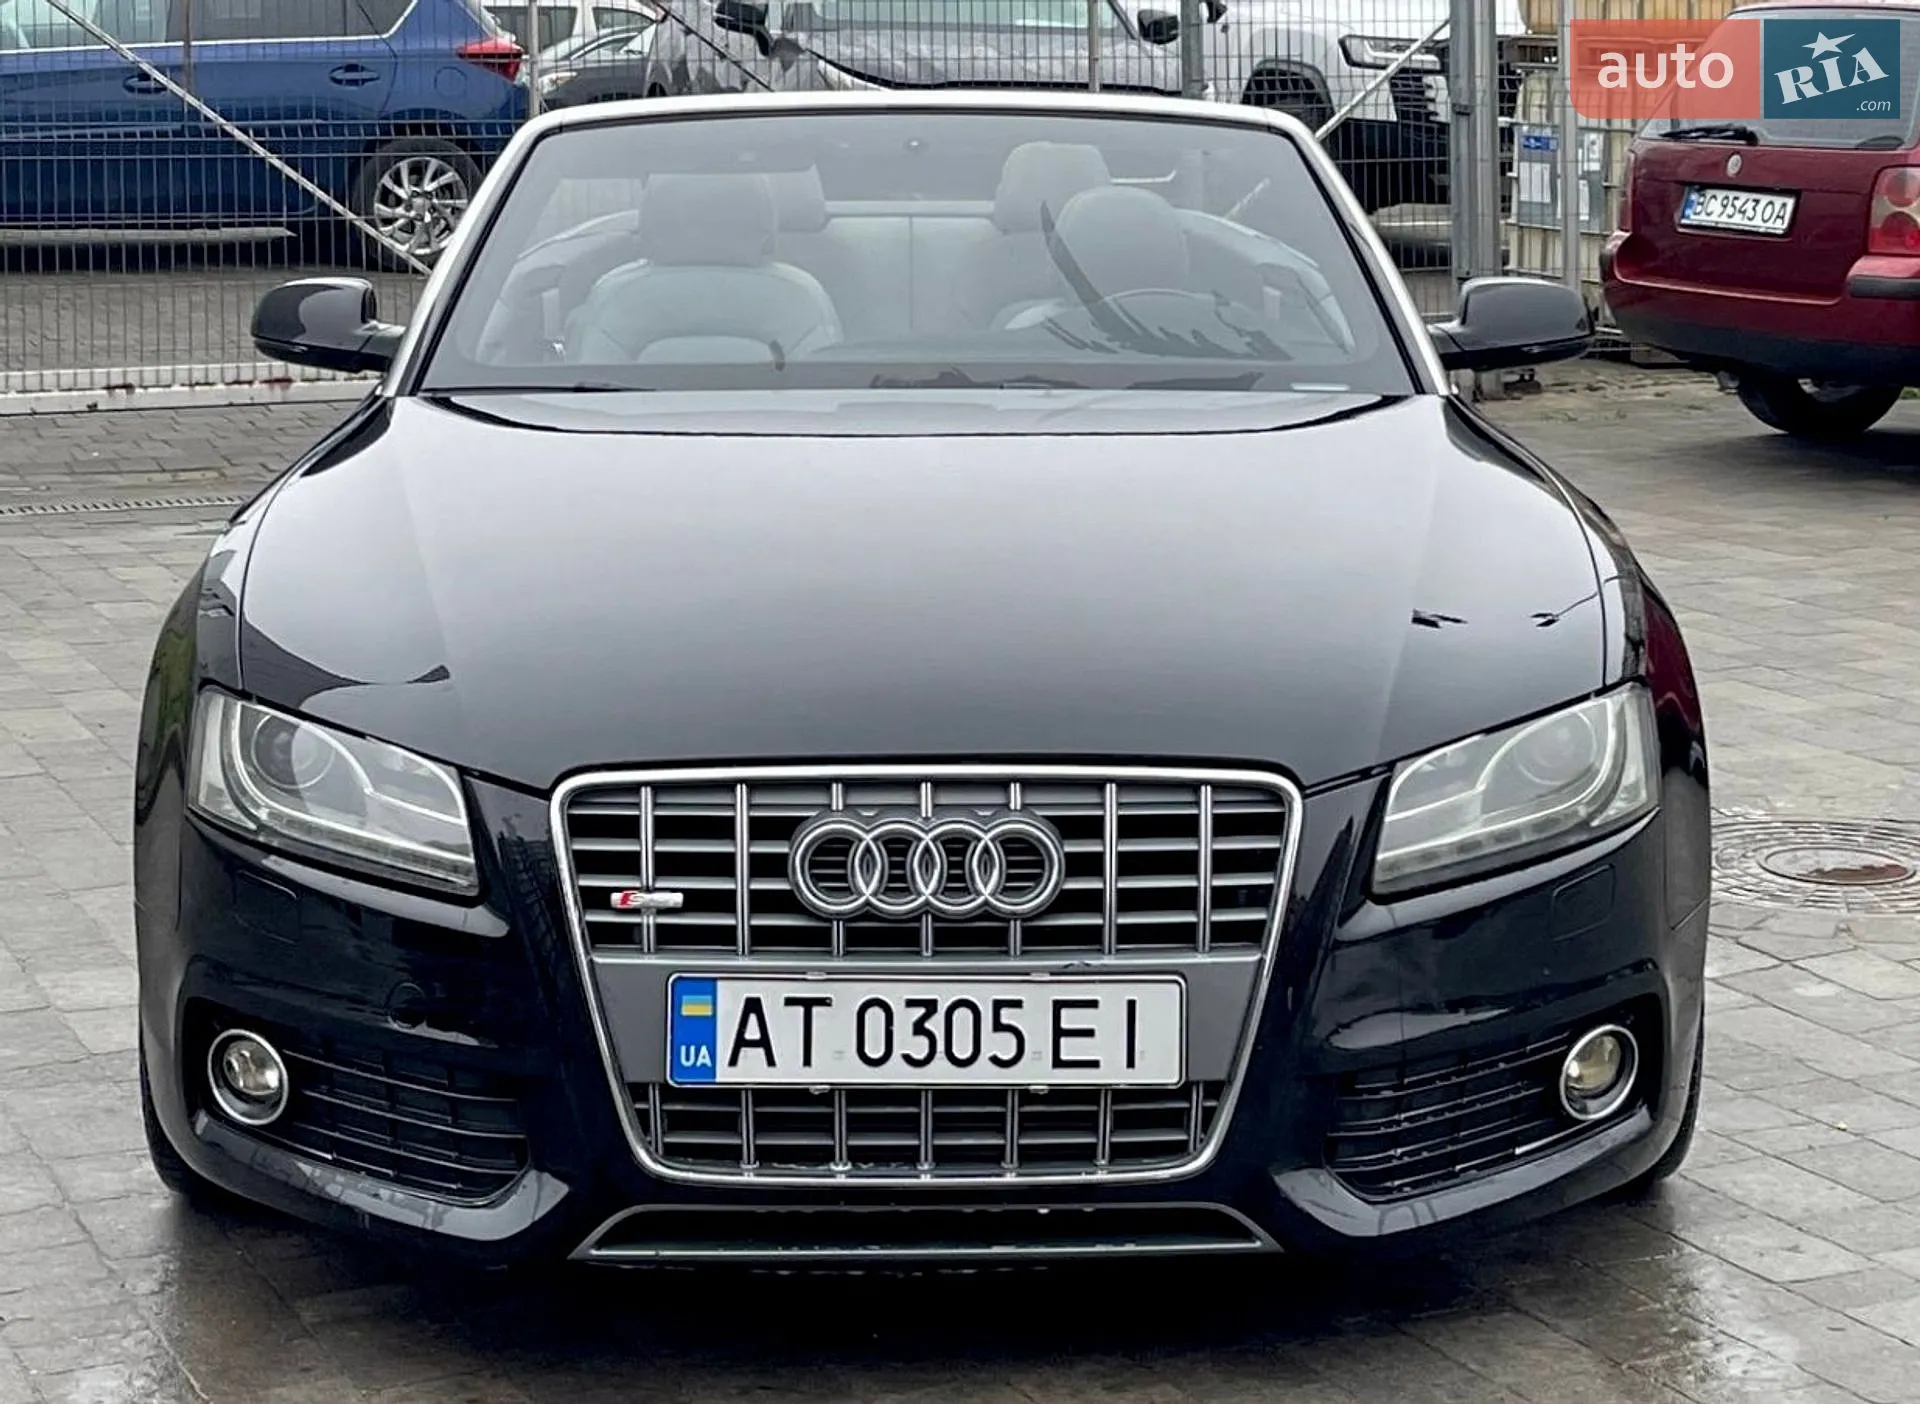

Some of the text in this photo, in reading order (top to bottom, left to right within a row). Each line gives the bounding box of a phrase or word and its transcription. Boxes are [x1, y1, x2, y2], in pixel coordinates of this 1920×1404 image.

[1717, 195, 1759, 221] 9543
[1761, 200, 1788, 225] OA
[727, 996, 1136, 1069] AT 0305 EI
[680, 1045, 712, 1067] UA
